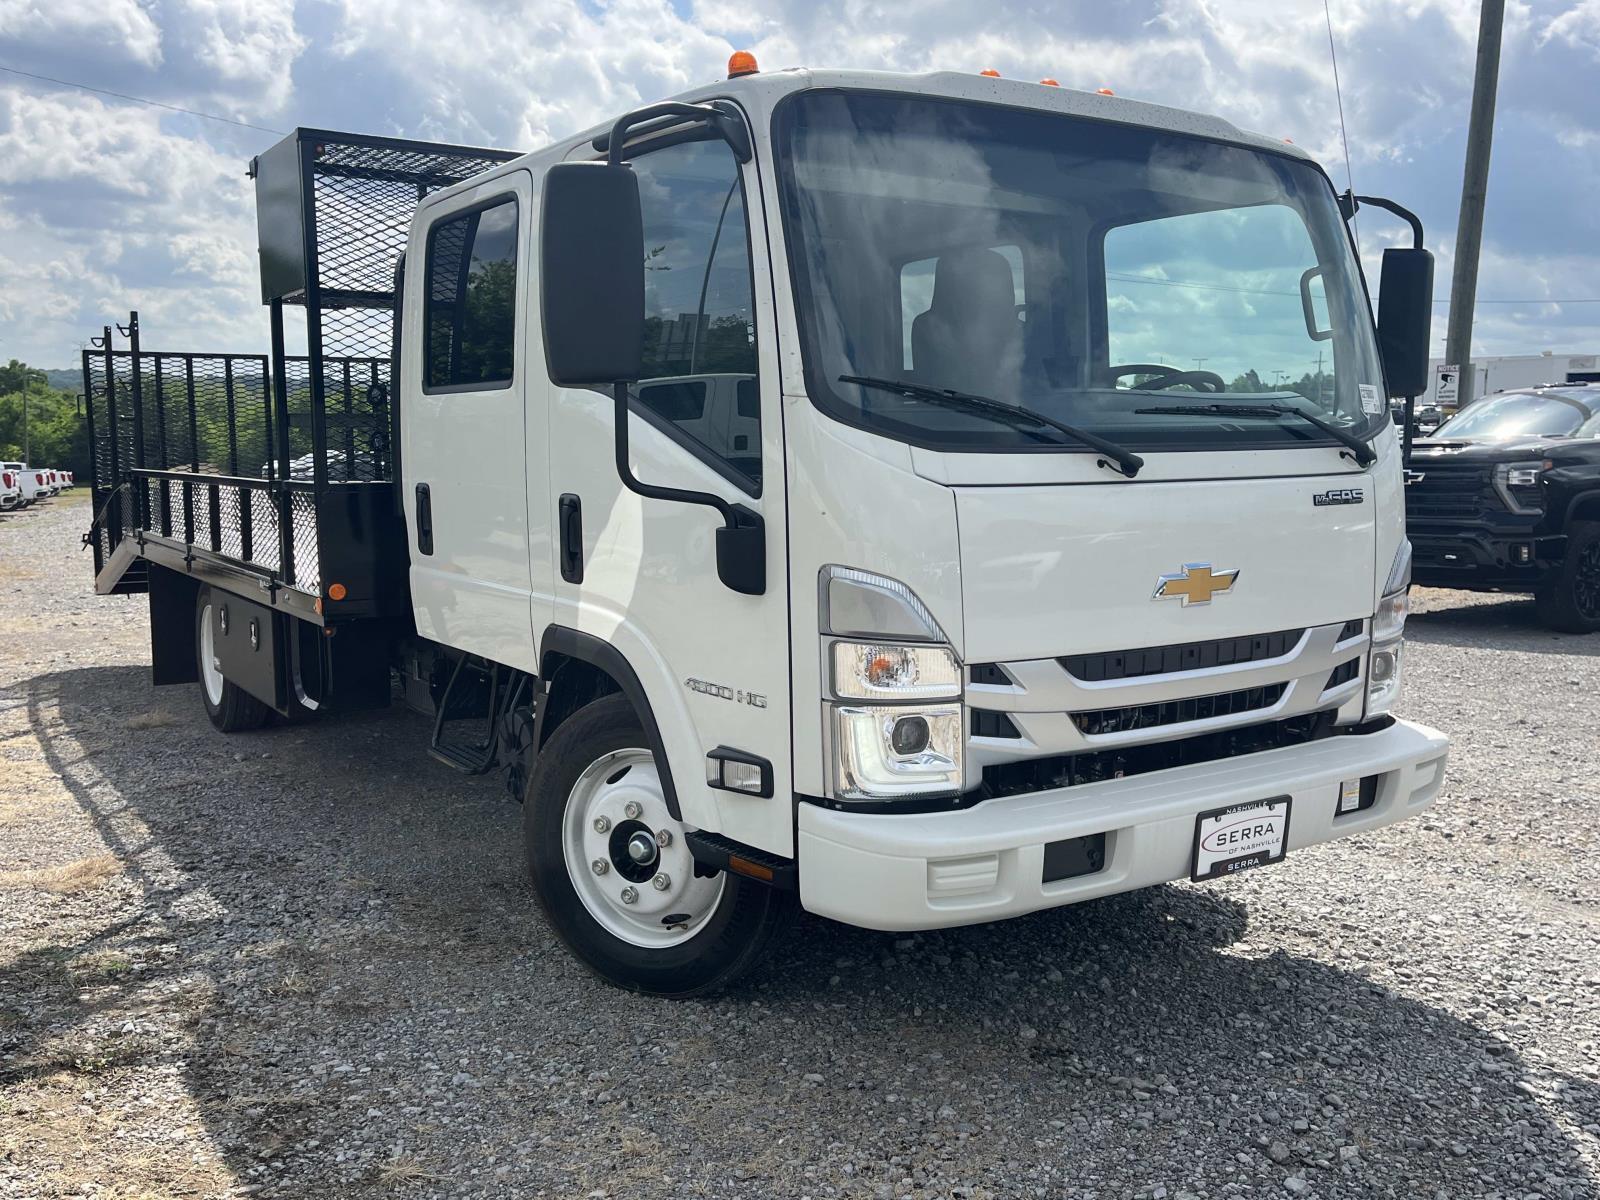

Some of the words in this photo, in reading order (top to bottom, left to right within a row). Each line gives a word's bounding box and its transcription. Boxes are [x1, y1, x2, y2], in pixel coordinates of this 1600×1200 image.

[736, 691, 767, 709] HG
[1226, 801, 1268, 814] NASHVILLE
[1217, 823, 1274, 846] SERRA
[1229, 847, 1239, 855] OF
[1240, 837, 1280, 851] NASHVILLE
[1228, 858, 1259, 871] SERRA
